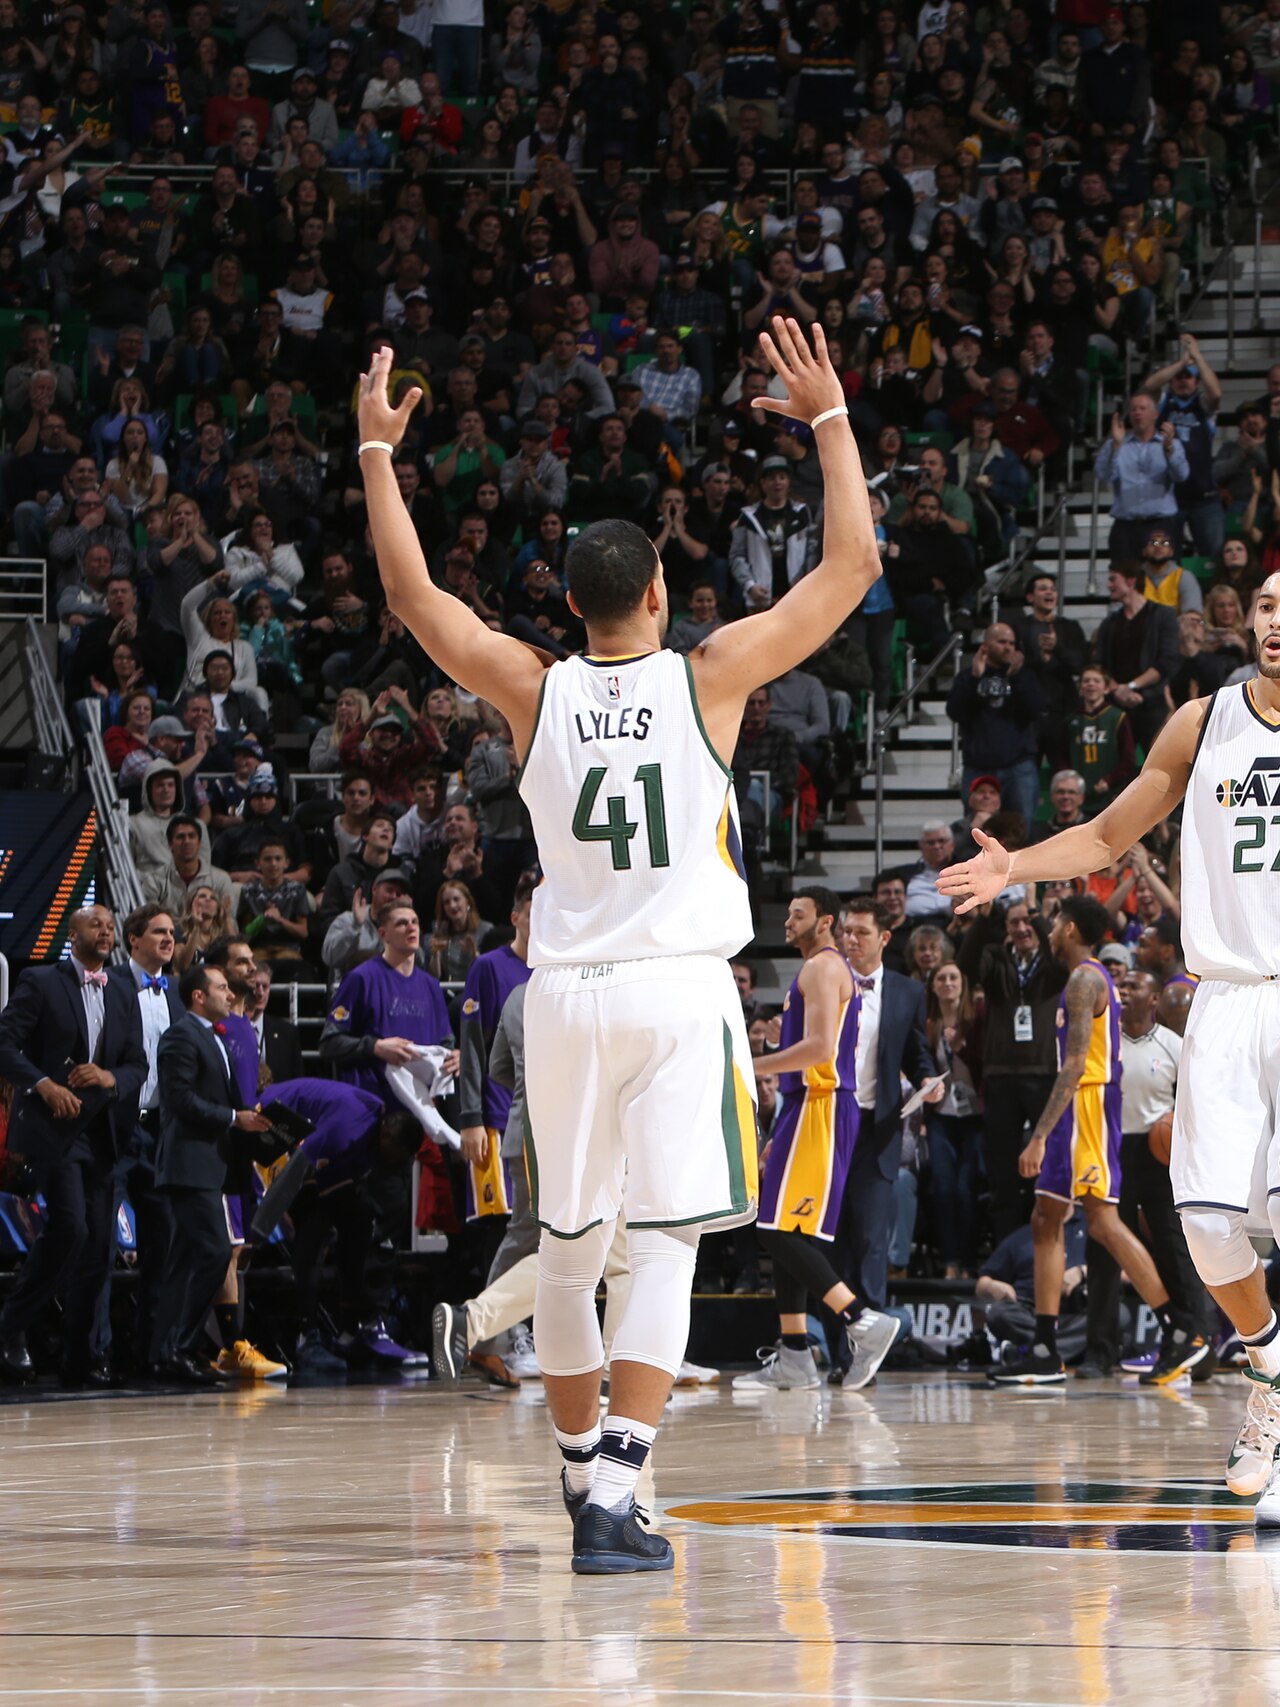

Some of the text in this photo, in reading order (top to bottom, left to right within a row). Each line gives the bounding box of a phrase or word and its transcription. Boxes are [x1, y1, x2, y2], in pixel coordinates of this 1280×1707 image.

[575, 707, 653, 743] LYLES
[571, 763, 670, 870] 41
[581, 963, 613, 979] UTAH
